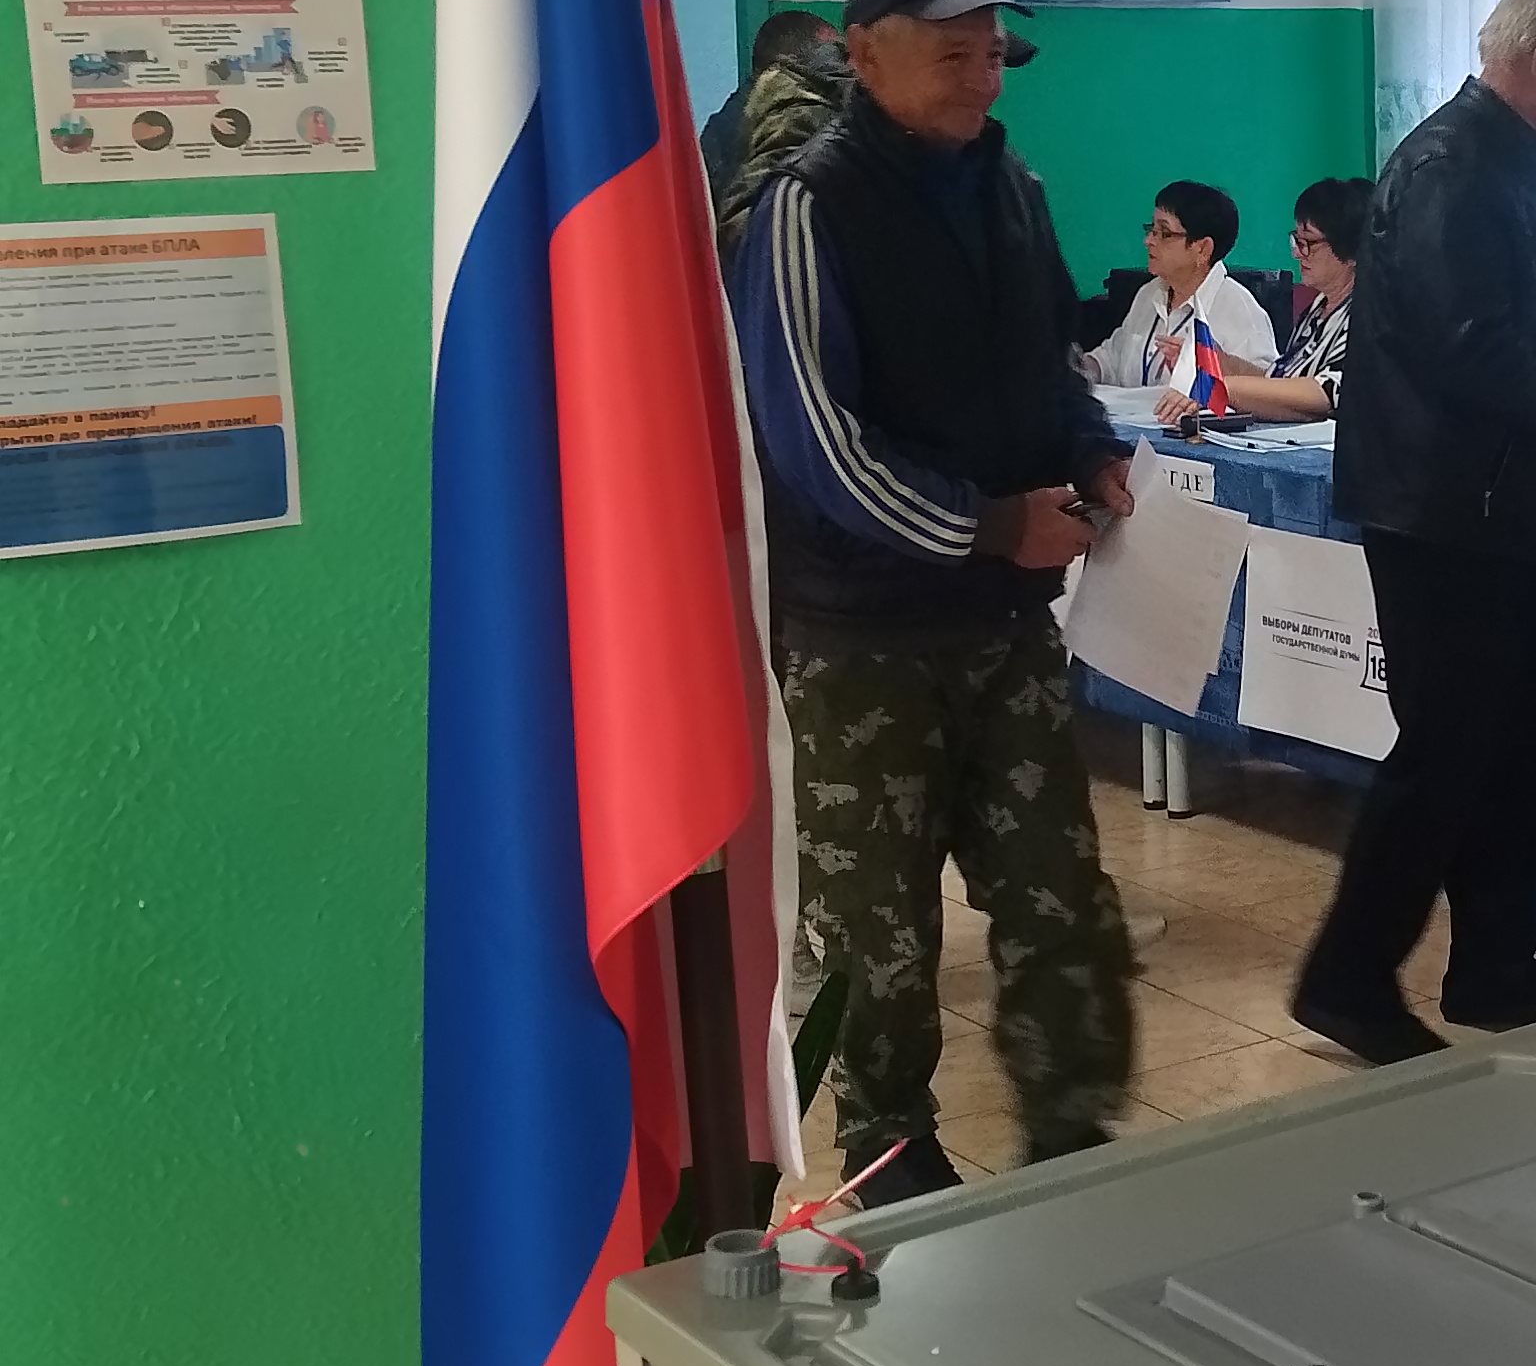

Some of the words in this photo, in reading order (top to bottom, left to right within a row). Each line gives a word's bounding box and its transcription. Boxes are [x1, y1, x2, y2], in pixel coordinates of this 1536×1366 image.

[62, 246, 96, 259] при
[99, 242, 149, 256] атаке
[152, 238, 201, 253] БПЛА
[59, 431, 80, 442] до
[1162, 468, 1204, 494] ГДЕ
[1262, 615, 1300, 634] ВЫБОРЫ
[1301, 623, 1351, 645] ДЕПУТАТОВ
[1272, 633, 1338, 657] ГОСУДАРСТВЕННОЙ
[1339, 648, 1360, 662] ДУМЫ
